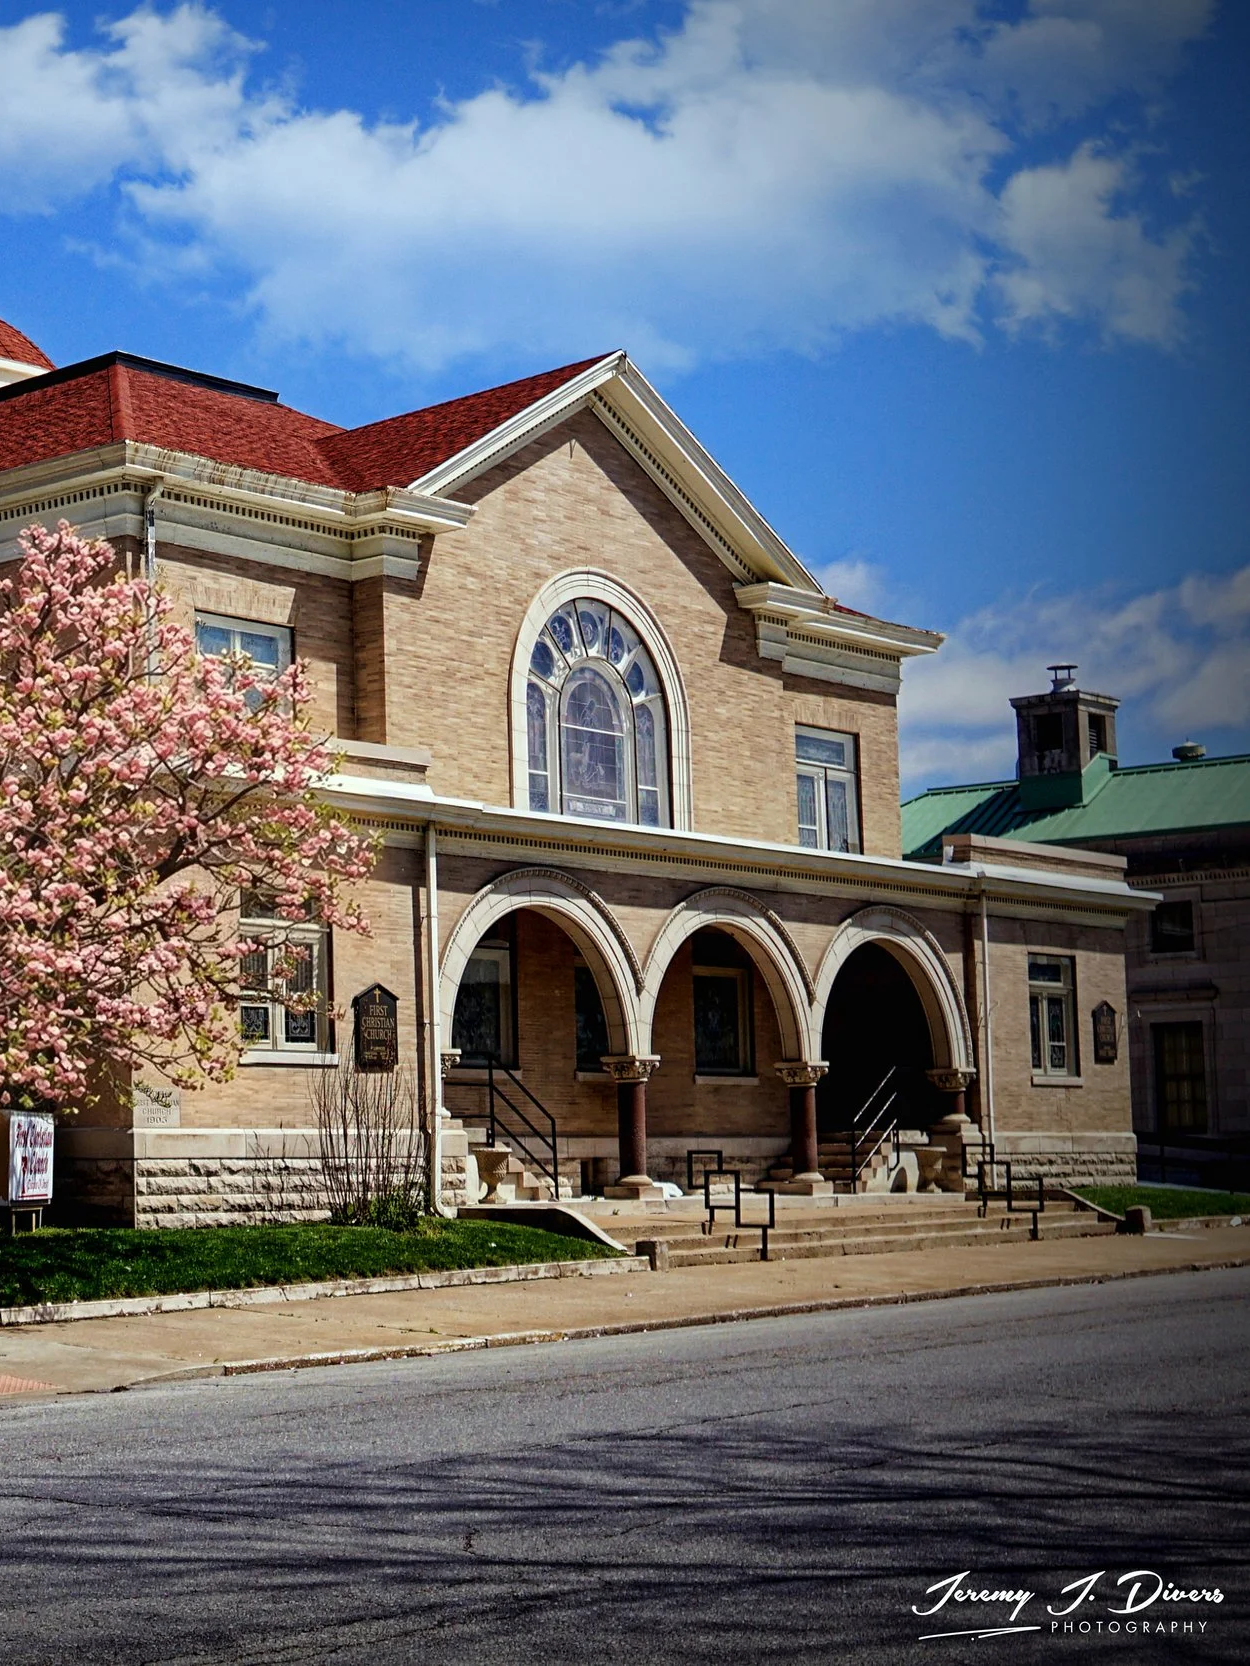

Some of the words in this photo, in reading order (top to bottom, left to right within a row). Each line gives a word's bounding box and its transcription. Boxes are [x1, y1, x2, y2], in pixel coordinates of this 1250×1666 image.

[369, 1005, 388, 1016] FIRST
[361, 1017, 395, 1030] CHRISTIAN
[365, 1029, 392, 1040] CHURCH
[142, 1107, 172, 1116] CHURCH
